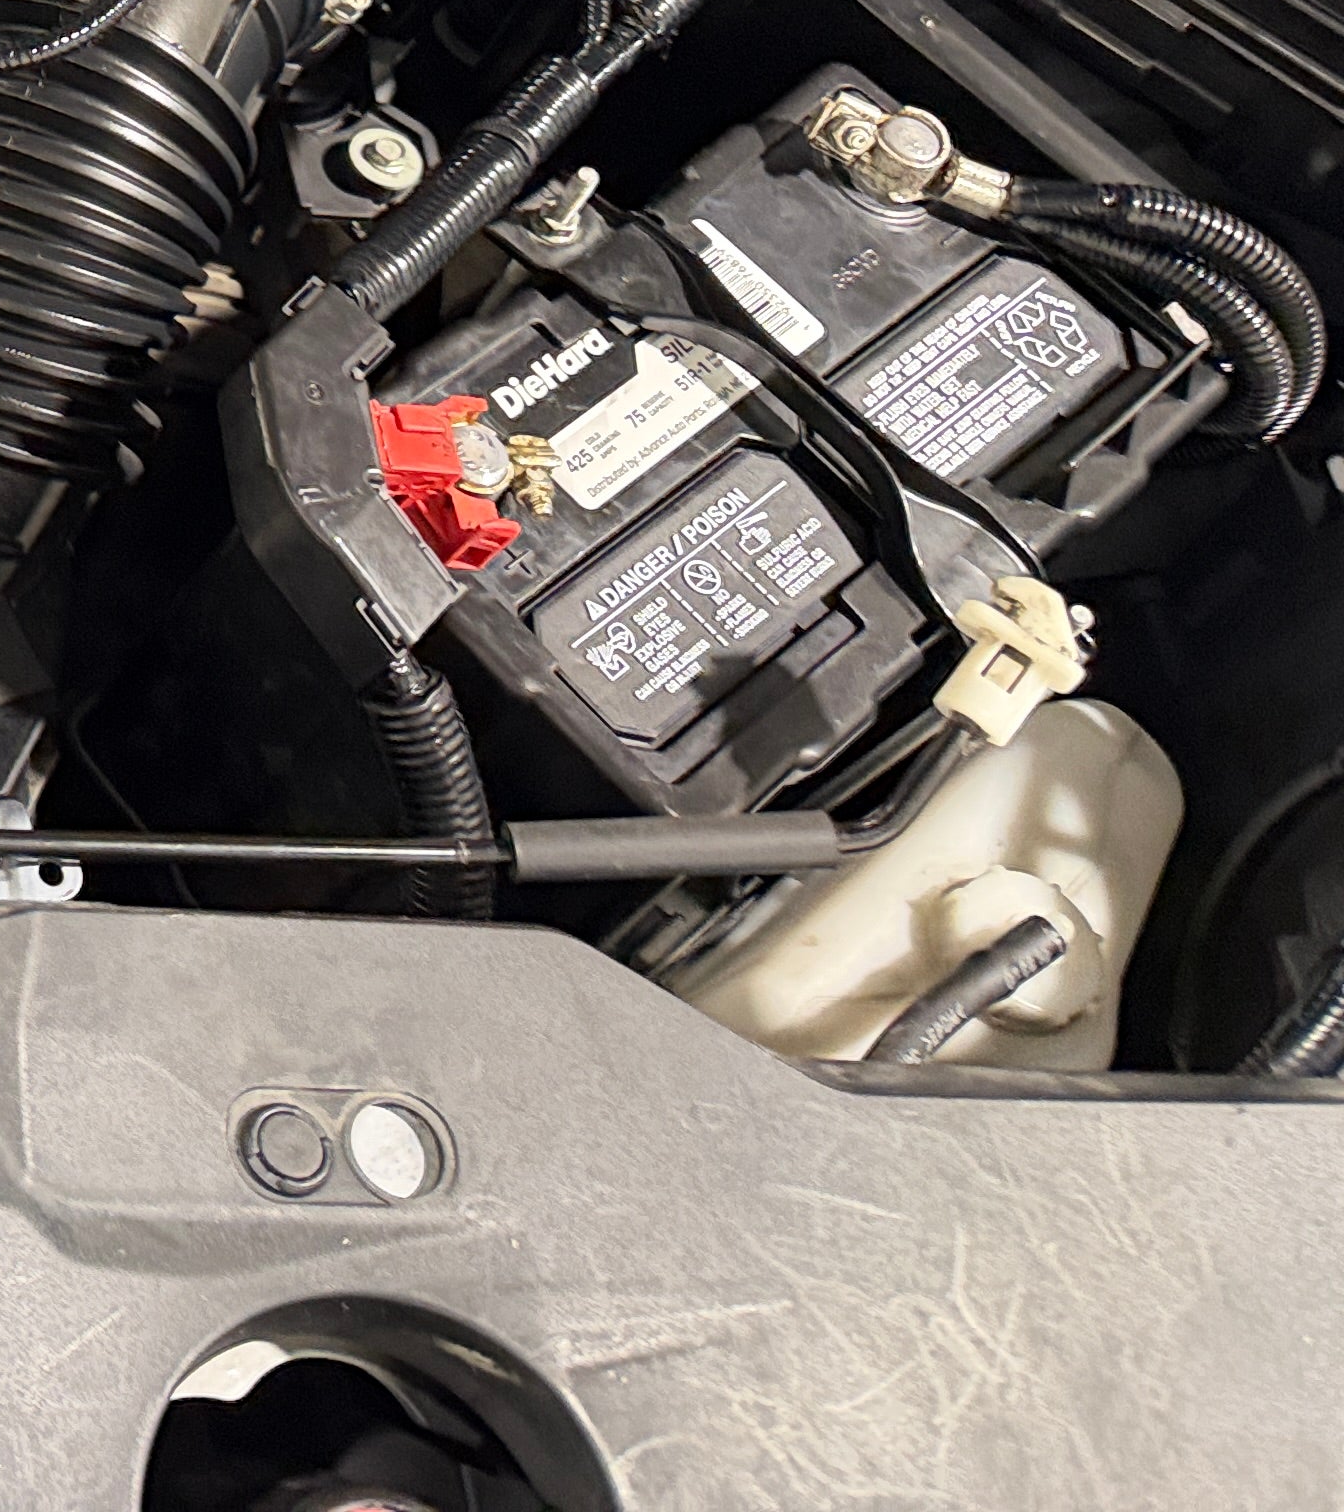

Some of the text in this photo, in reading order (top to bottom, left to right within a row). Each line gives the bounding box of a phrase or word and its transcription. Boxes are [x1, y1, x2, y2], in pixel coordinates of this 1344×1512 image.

[491, 328, 614, 418] DieHard
[660, 332, 694, 363] SIL
[903, 382, 931, 405] EYES
[925, 344, 980, 388] IMMEDIATELY
[1065, 348, 1100, 377] RECYCLE
[566, 448, 594, 473] 425
[624, 409, 647, 428] 75
[674, 361, 713, 391] 51R-1
[888, 413, 917, 436] WITH
[940, 376, 962, 396] GET
[900, 379, 982, 446] MEDICAL HELP FAST
[587, 461, 629, 498] Distributed
[638, 434, 670, 460] Advance
[667, 421, 687, 437] Auto
[605, 488, 750, 605] DANGER / POISON
[756, 517, 822, 571] SULFURIC ACID
[765, 542, 808, 580] CAN CAUSE
[633, 596, 668, 626] SHIELD
[711, 588, 731, 606] NO
[634, 620, 686, 662] EXPLOSIVE
[643, 612, 671, 637] EYES
[634, 639, 711, 701] CAN CAUSE BLINDNESS
[645, 643, 680, 673] GASES
